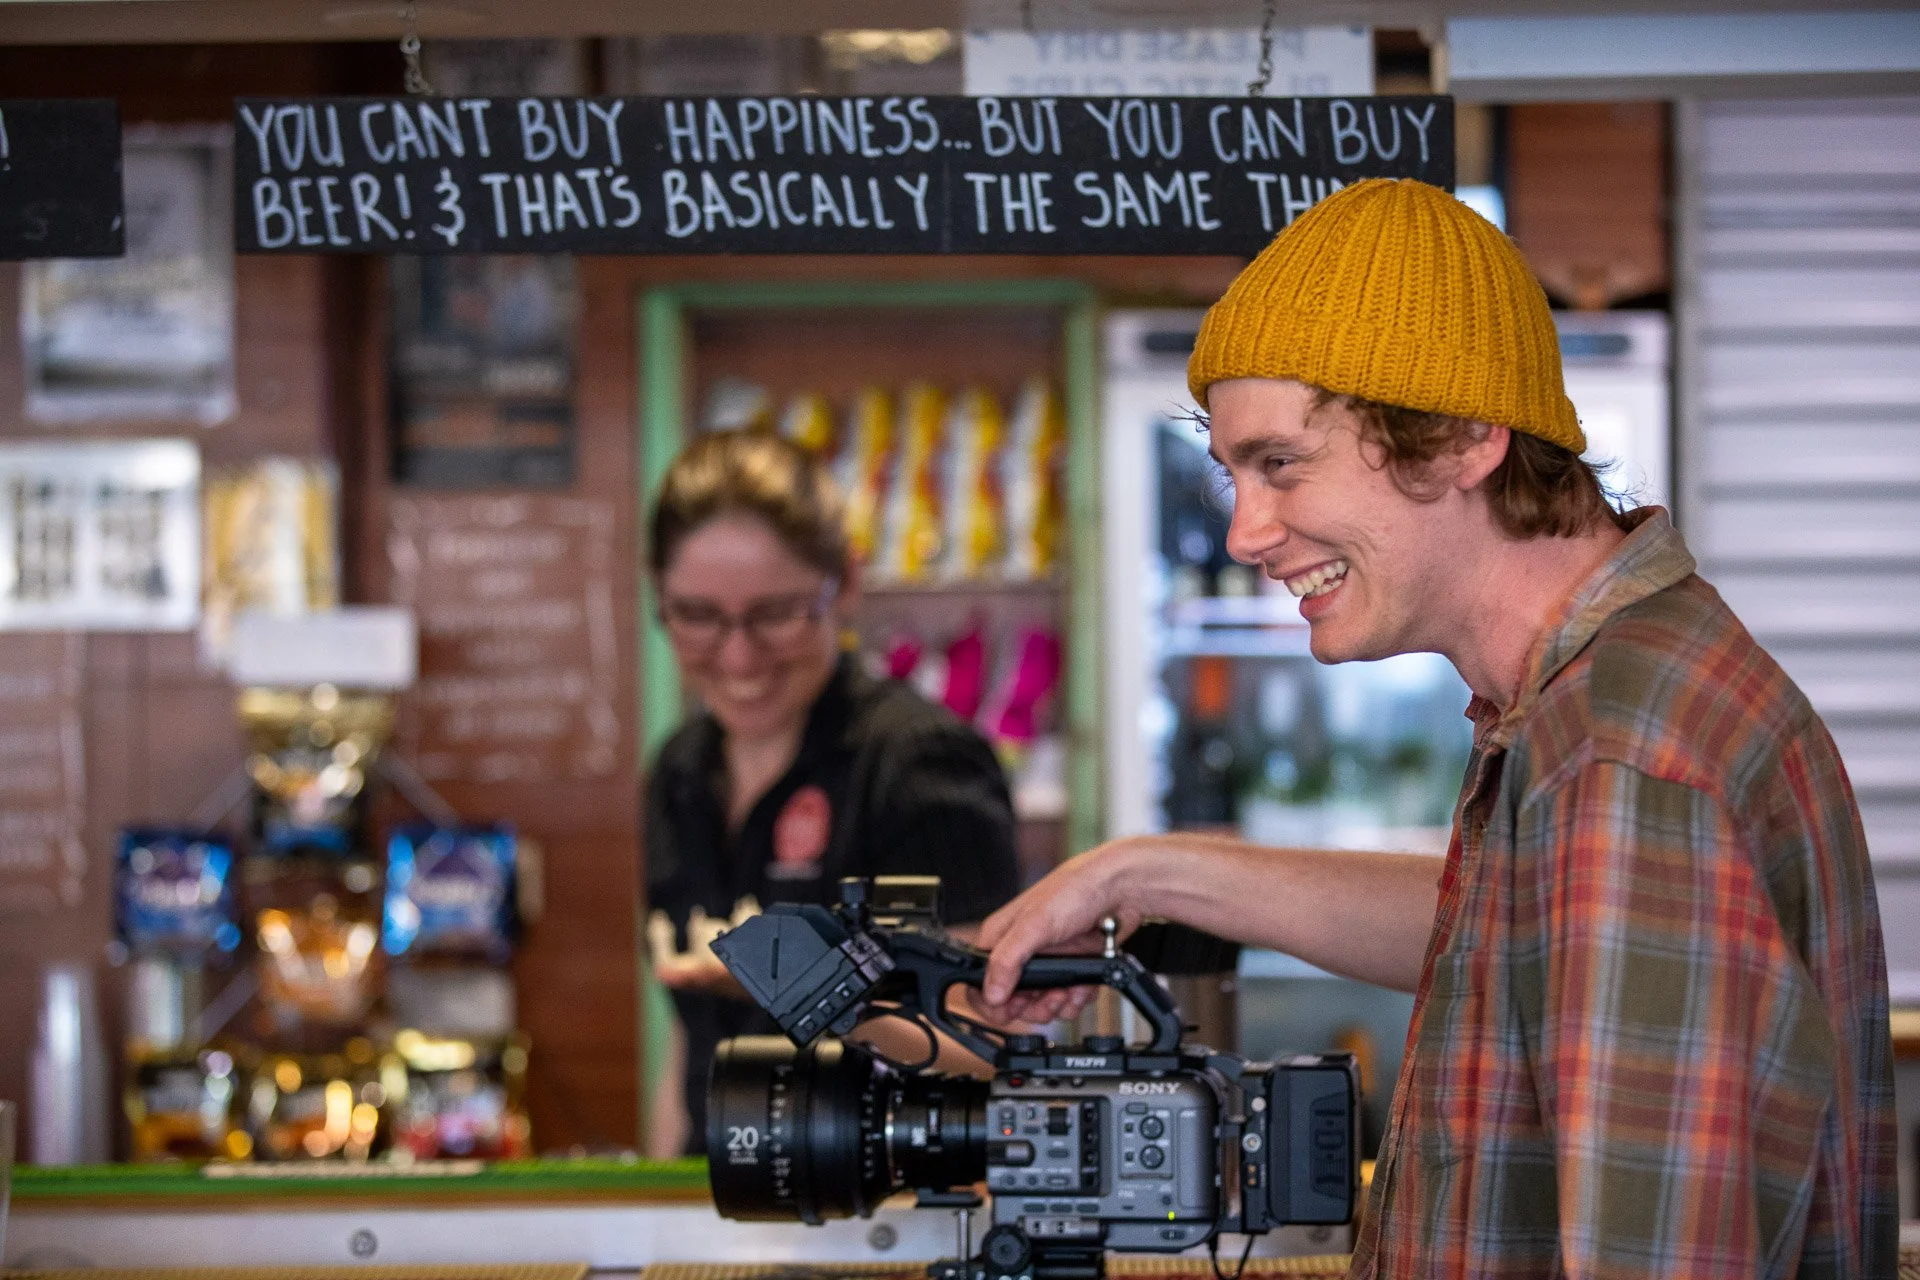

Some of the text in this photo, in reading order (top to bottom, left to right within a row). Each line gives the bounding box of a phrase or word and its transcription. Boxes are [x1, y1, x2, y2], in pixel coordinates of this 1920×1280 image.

[240, 104, 345, 173] YOU
[360, 100, 491, 163] CANT
[518, 98, 624, 166] BUY
[978, 97, 1062, 157] BUT
[1084, 98, 1182, 160] YOU
[1209, 98, 1305, 164] CAN
[1330, 99, 1436, 164] BUY
[253, 172, 416, 248] BEER!
[479, 166, 642, 238] THAT'S
[662, 169, 929, 238] BASICALLY
[964, 172, 1057, 234] THE
[1074, 171, 1221, 231] SAME
[1119, 1081, 1181, 1095] SONY
[727, 1126, 759, 1150] 20
